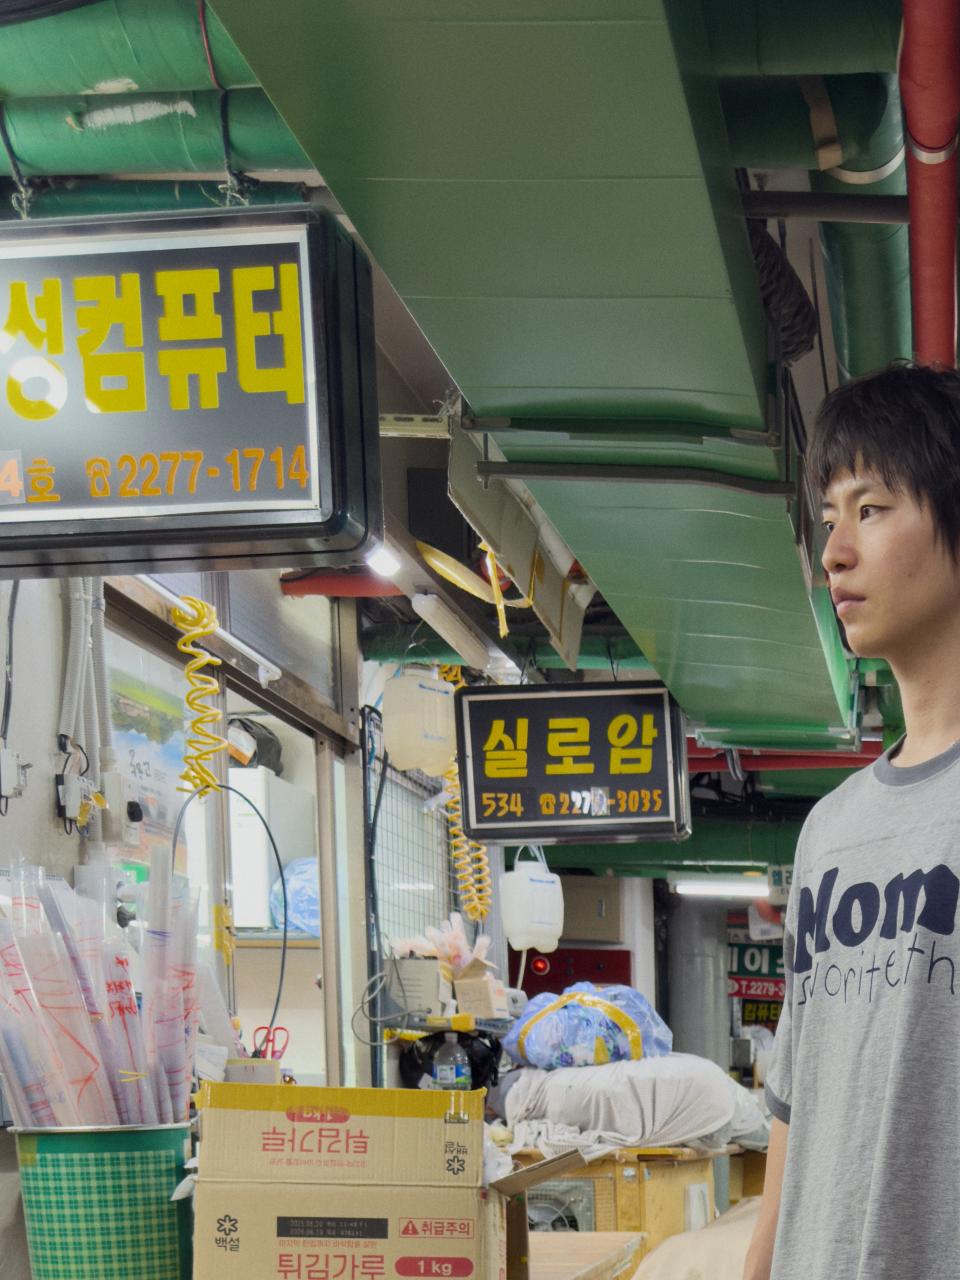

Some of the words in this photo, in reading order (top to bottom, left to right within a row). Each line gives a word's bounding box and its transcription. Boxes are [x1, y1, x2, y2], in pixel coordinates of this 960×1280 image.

[0, 262, 306, 421] 성컴퓨터
[117, 445, 309, 498] 2277-1714
[482, 713, 659, 779] 실로암
[481, 792, 524, 818] 534
[261, 1126, 370, 1154] 튀김가루
[421, 1220, 471, 1236] 취급주의
[214, 1236, 240, 1251] 백설
[277, 1253, 386, 1280] 튀김가루
[431, 1260, 453, 1275] kg
